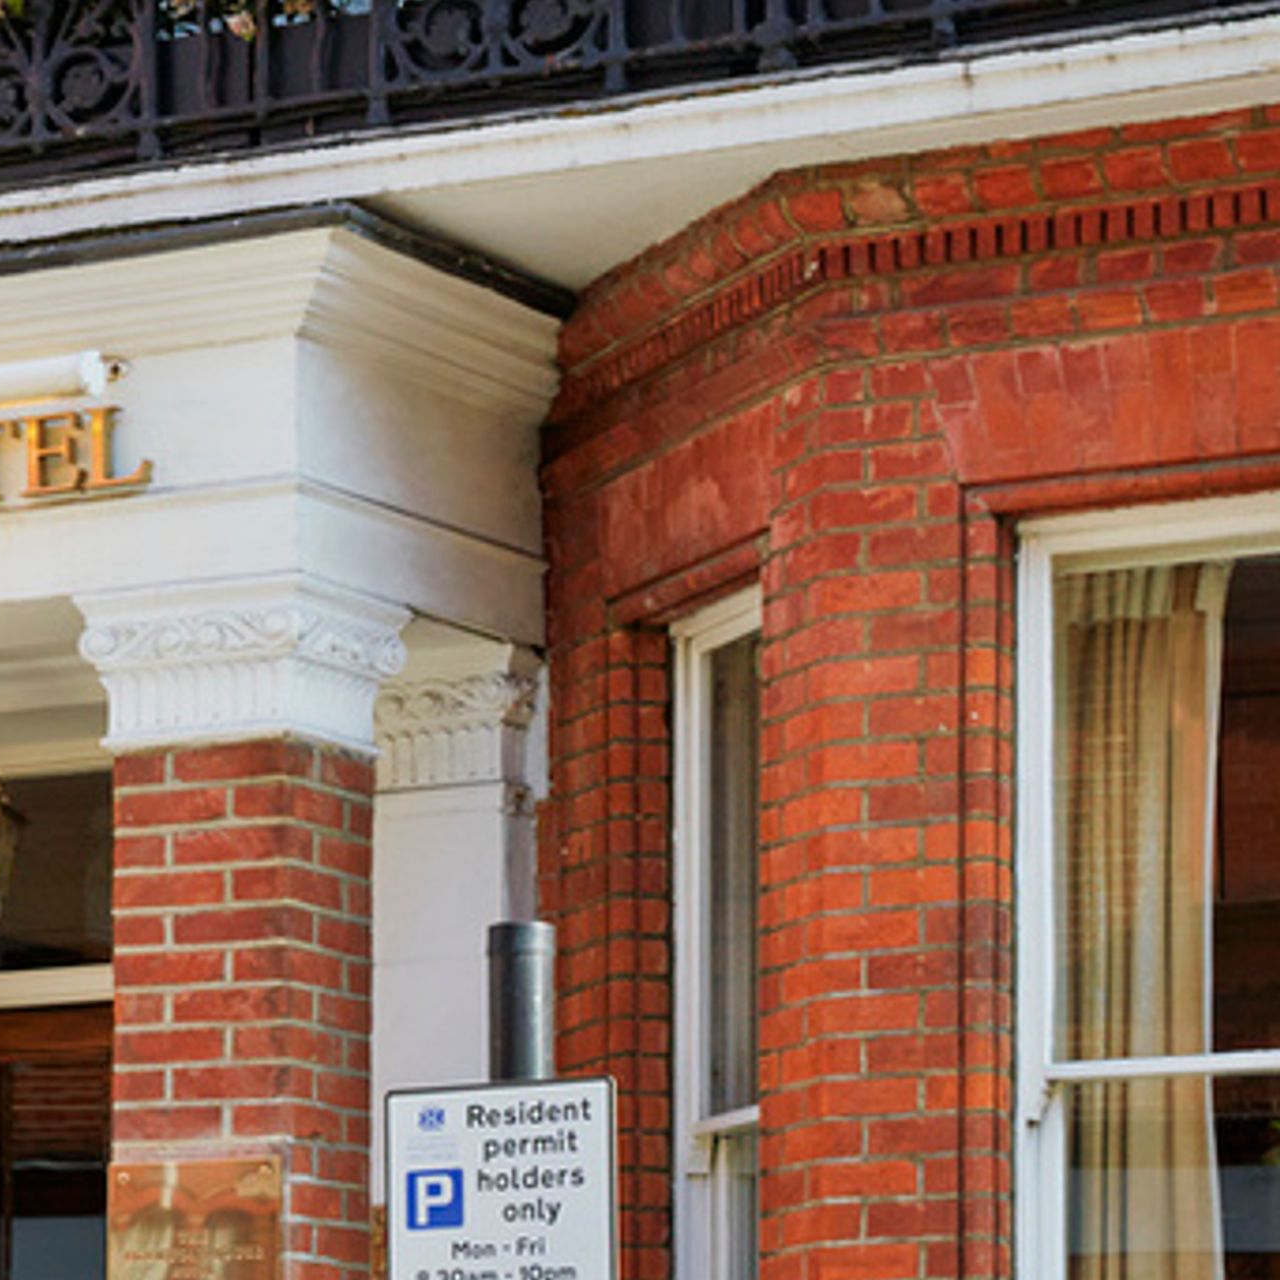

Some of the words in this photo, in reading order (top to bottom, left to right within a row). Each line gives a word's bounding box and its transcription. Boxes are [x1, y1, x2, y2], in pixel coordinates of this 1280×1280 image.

[465, 1098, 592, 1128] Resident
[483, 1130, 578, 1162] permit
[477, 1165, 585, 1192] holders
[414, 1175, 454, 1226] P
[502, 1199, 561, 1226] only
[451, 1242, 496, 1260] Mon
[515, 1236, 545, 1257] Fri
